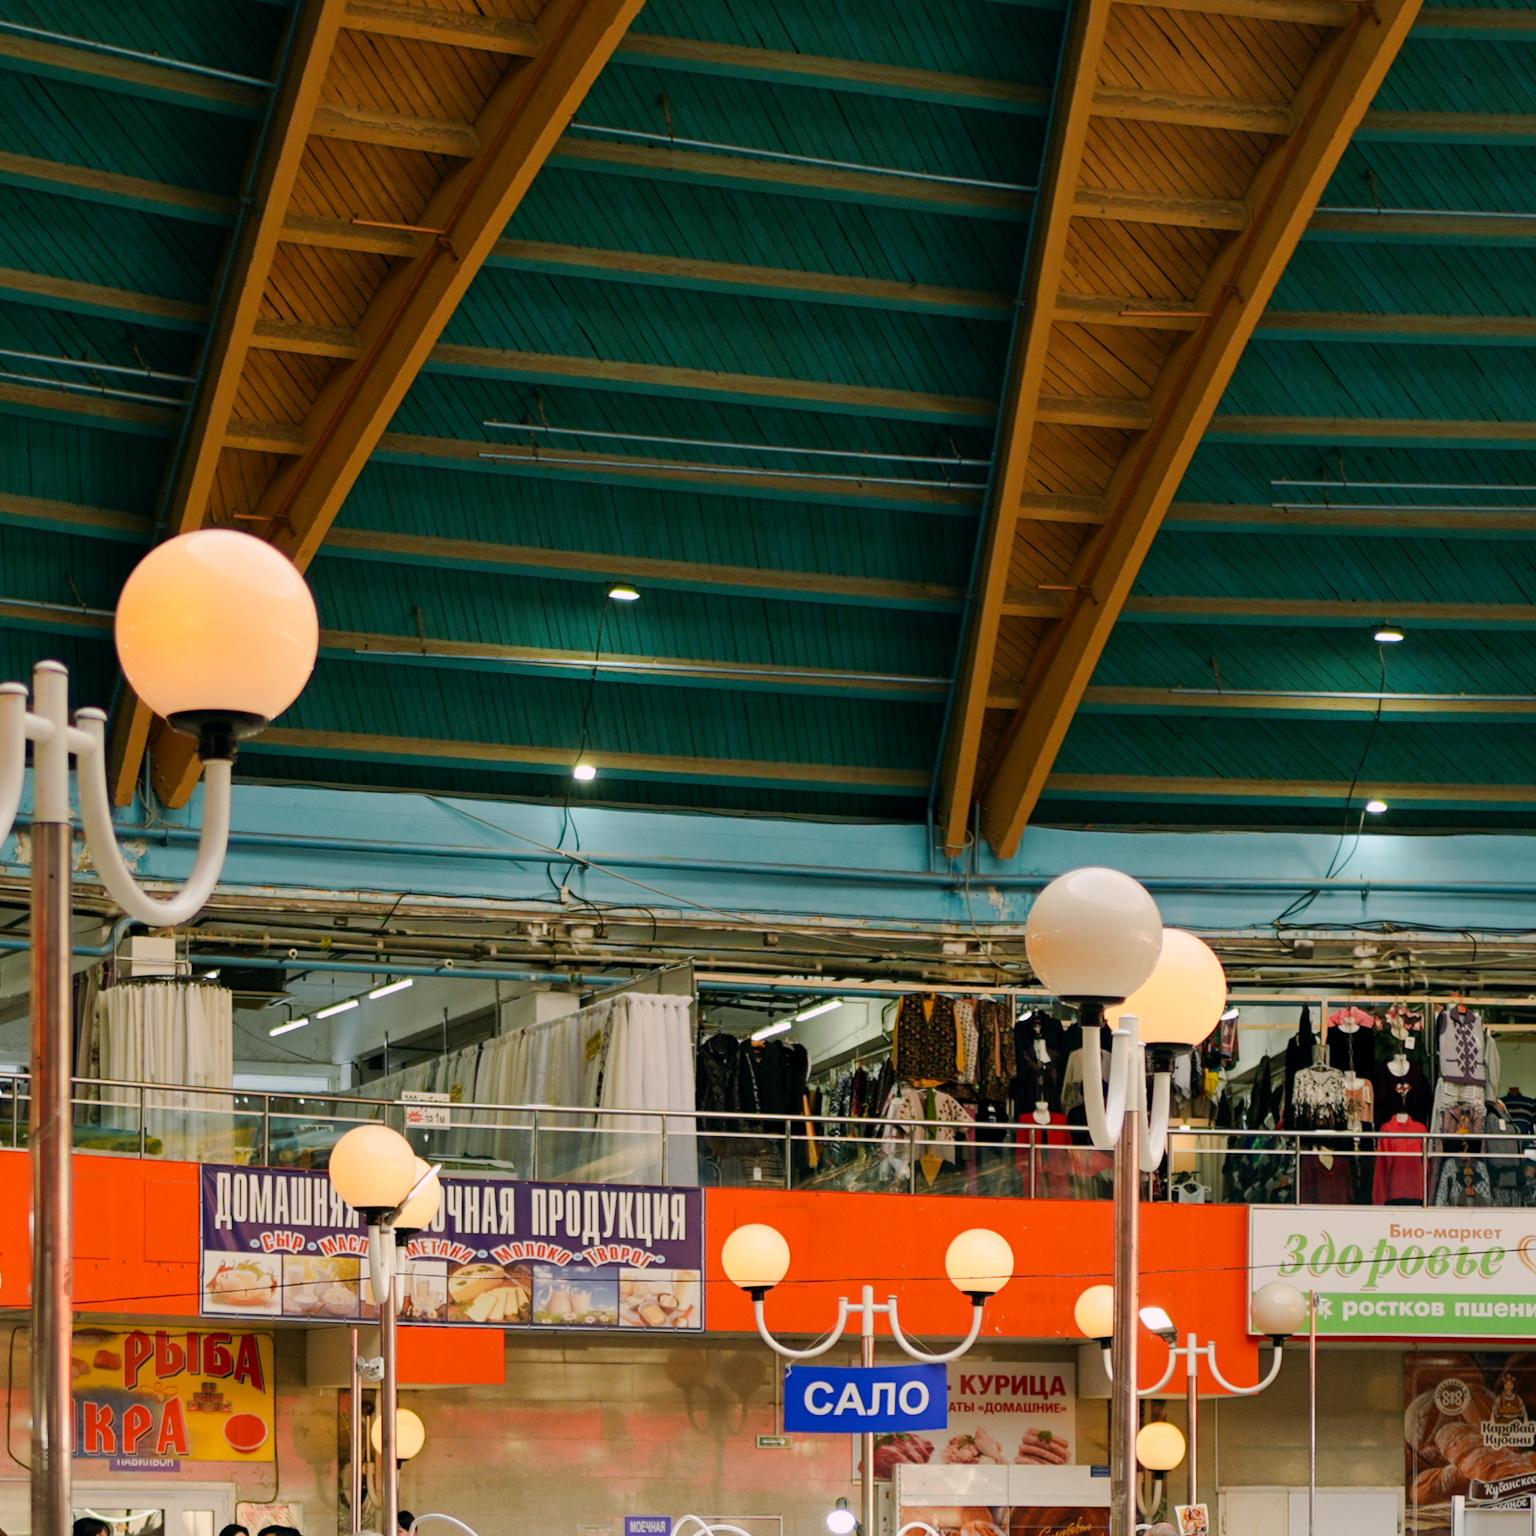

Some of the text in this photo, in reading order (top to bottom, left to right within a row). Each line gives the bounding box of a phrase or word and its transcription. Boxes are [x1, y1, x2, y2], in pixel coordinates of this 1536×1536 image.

[424, 1185, 515, 1235] ОЧНАЯ
[531, 1188, 686, 1247] ПРОДУКЦИЯ
[1389, 1224, 1502, 1243] Био-маркет
[260, 1230, 655, 1270] СЫР МАСЛ МЕТАНА МОЛОКО ТВОРОГ
[1277, 1229, 1506, 1291] Здоровье
[1342, 1300, 1446, 1321] ростков
[124, 1329, 265, 1393] РЫБА
[803, 1380, 930, 1416] САЛО
[960, 1374, 1067, 1400] КУРИЦА
[948, 1403, 1067, 1414] АТЫ «ДОМАШНИЕ»
[73, 1397, 189, 1456] КРА
[1484, 1435, 1533, 1448] Кубани
[629, 1520, 666, 1533] МОЕЧНАЯ
